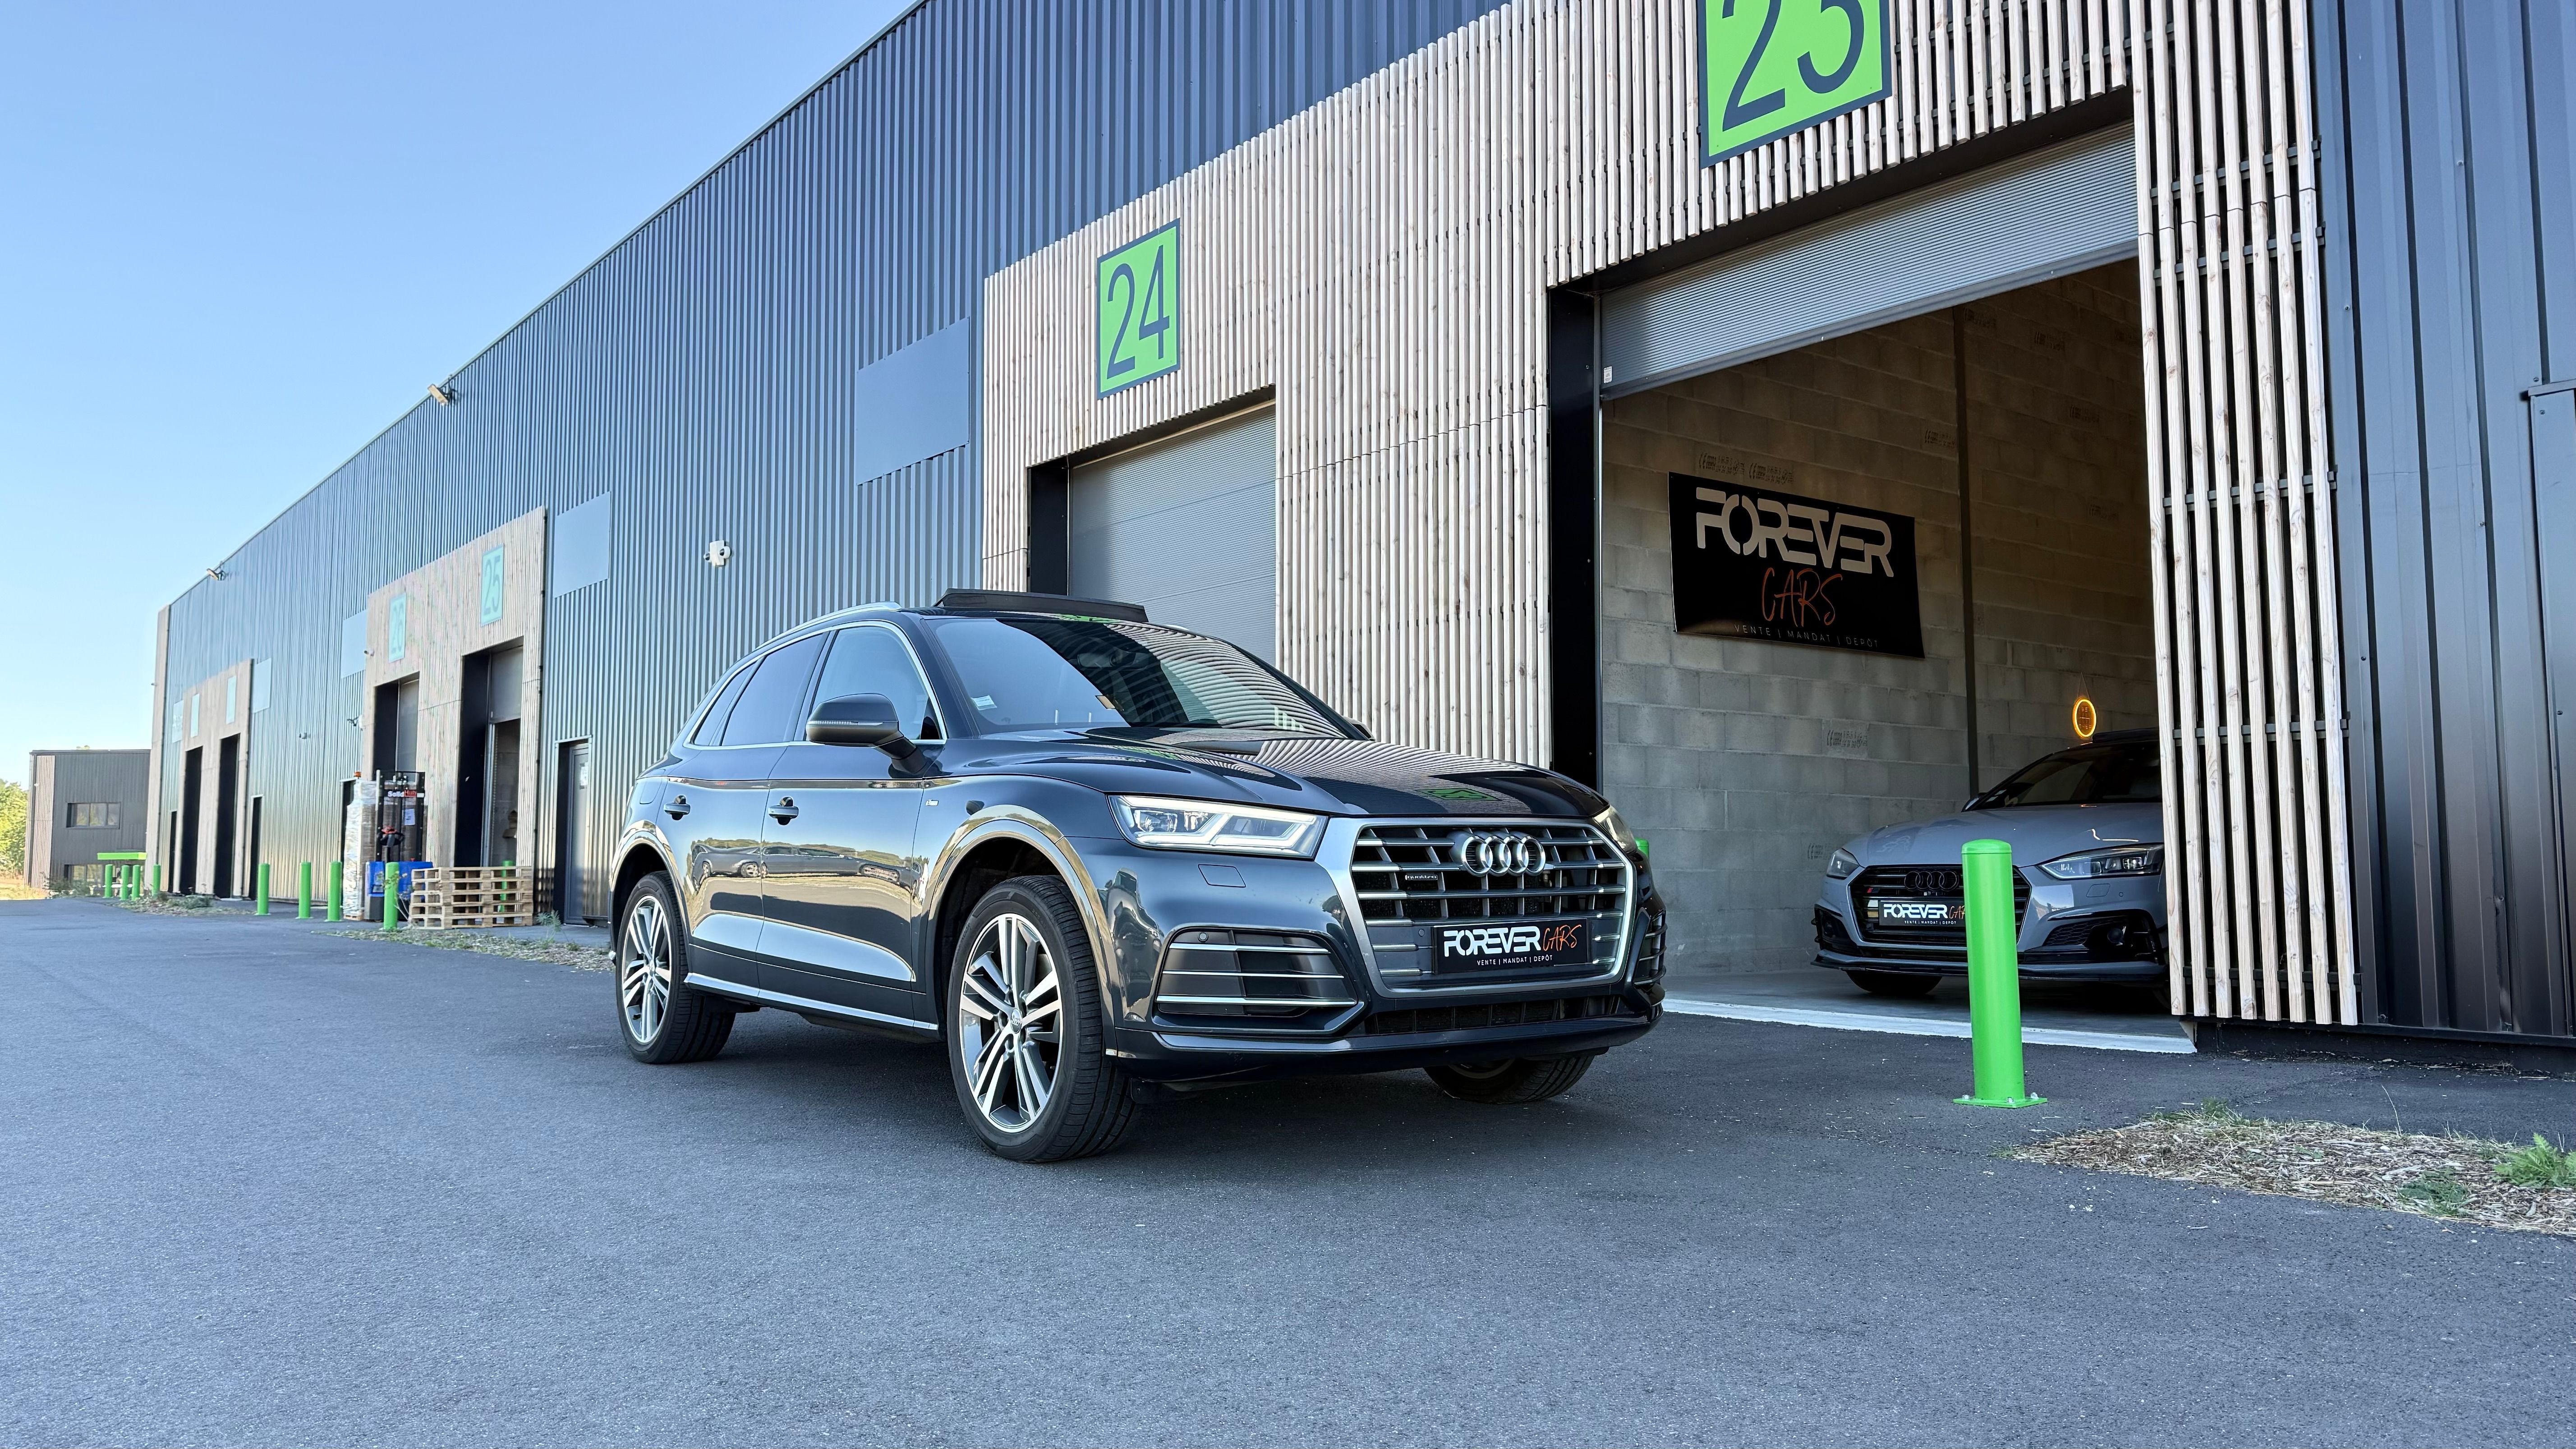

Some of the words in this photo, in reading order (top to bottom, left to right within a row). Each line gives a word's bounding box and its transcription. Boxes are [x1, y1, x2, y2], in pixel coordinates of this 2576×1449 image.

[1107, 244, 1170, 379] 24
[1696, 487, 1894, 577] FOREVER
[483, 555, 501, 616] 25
[1761, 567, 1843, 627] CARS
[391, 601, 404, 654] 26
[1734, 624, 1771, 636] VENTE
[1787, 630, 1831, 643] MANDAT
[1883, 903, 1948, 919] FOREVER
[1949, 905, 1965, 920] CA
[1444, 926, 1541, 957] FOREVER
[1543, 924, 1582, 952] CARS
